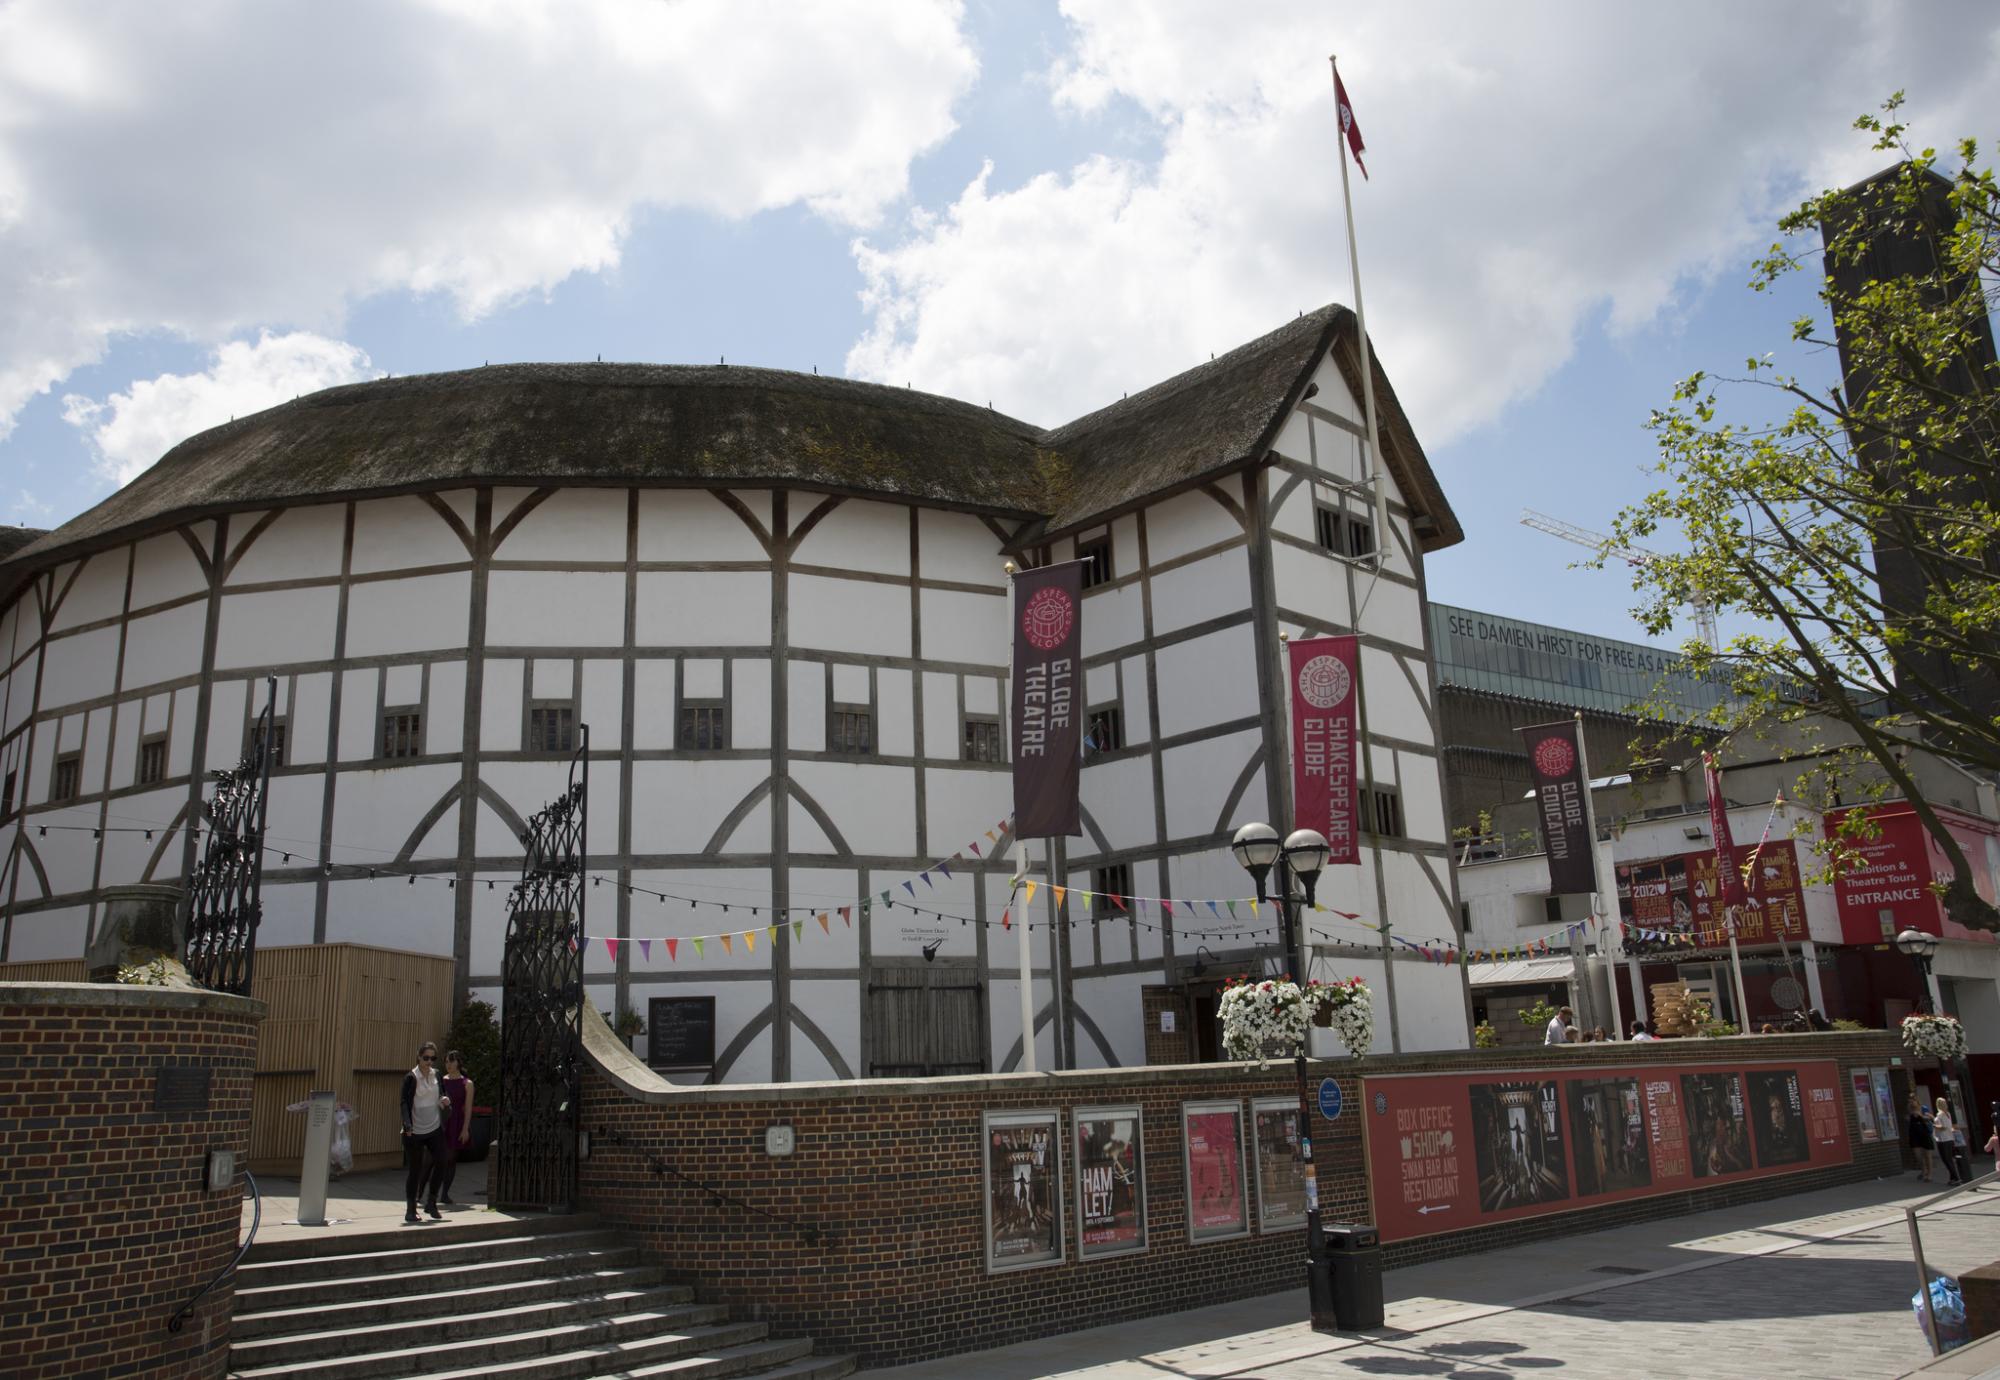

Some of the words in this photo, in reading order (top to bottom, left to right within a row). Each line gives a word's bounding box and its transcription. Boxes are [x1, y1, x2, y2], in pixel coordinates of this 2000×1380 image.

[1025, 590, 1073, 633] SHAKESPEARE'S
[1030, 632, 1066, 648] GLOBE
[1450, 615, 1474, 638] SEE
[1478, 621, 1535, 648] DAMIEN
[1537, 633, 1574, 656] HIRST
[1576, 642, 1604, 663] FOR
[1605, 646, 1635, 668] FREE
[1637, 653, 1654, 672] AS
[1656, 657, 1664, 672] A
[1301, 657, 1349, 696] SHAKESPEARE'S
[1050, 659, 1072, 731] GLOBE
[1308, 693, 1344, 707] GLOBE
[1021, 662, 1047, 757] THEATRE
[1304, 718, 1325, 777] GLOBE
[1329, 717, 1350, 857] SHAKESPEARE'S
[1561, 782, 1582, 828] GLOBE
[1542, 784, 1568, 860] EDUCATION
[1761, 855, 1790, 866] TAMING
[1845, 863, 1896, 877] Exhibition
[1898, 861, 1907, 870] &
[1764, 878, 1794, 890] SHREW
[1846, 877, 1886, 888] Theatre
[1888, 873, 1917, 884] Tours
[1846, 888, 1921, 906] ENTRANCE
[1740, 911, 1764, 927] YOU
[1784, 892, 1803, 934] TWELFTH
[1397, 1108, 1418, 1132] BOX
[1419, 1106, 1453, 1129] OFFICE
[1645, 1081, 1661, 1144] THEATRE
[1412, 1130, 1443, 1158] SHOP
[1083, 1167, 1113, 1193] HAM
[1401, 1160, 1425, 1180] SWAN
[1426, 1158, 1443, 1176] BAR
[1443, 1156, 1458, 1174] AND
[1403, 1176, 1460, 1203] RESTAURANT
